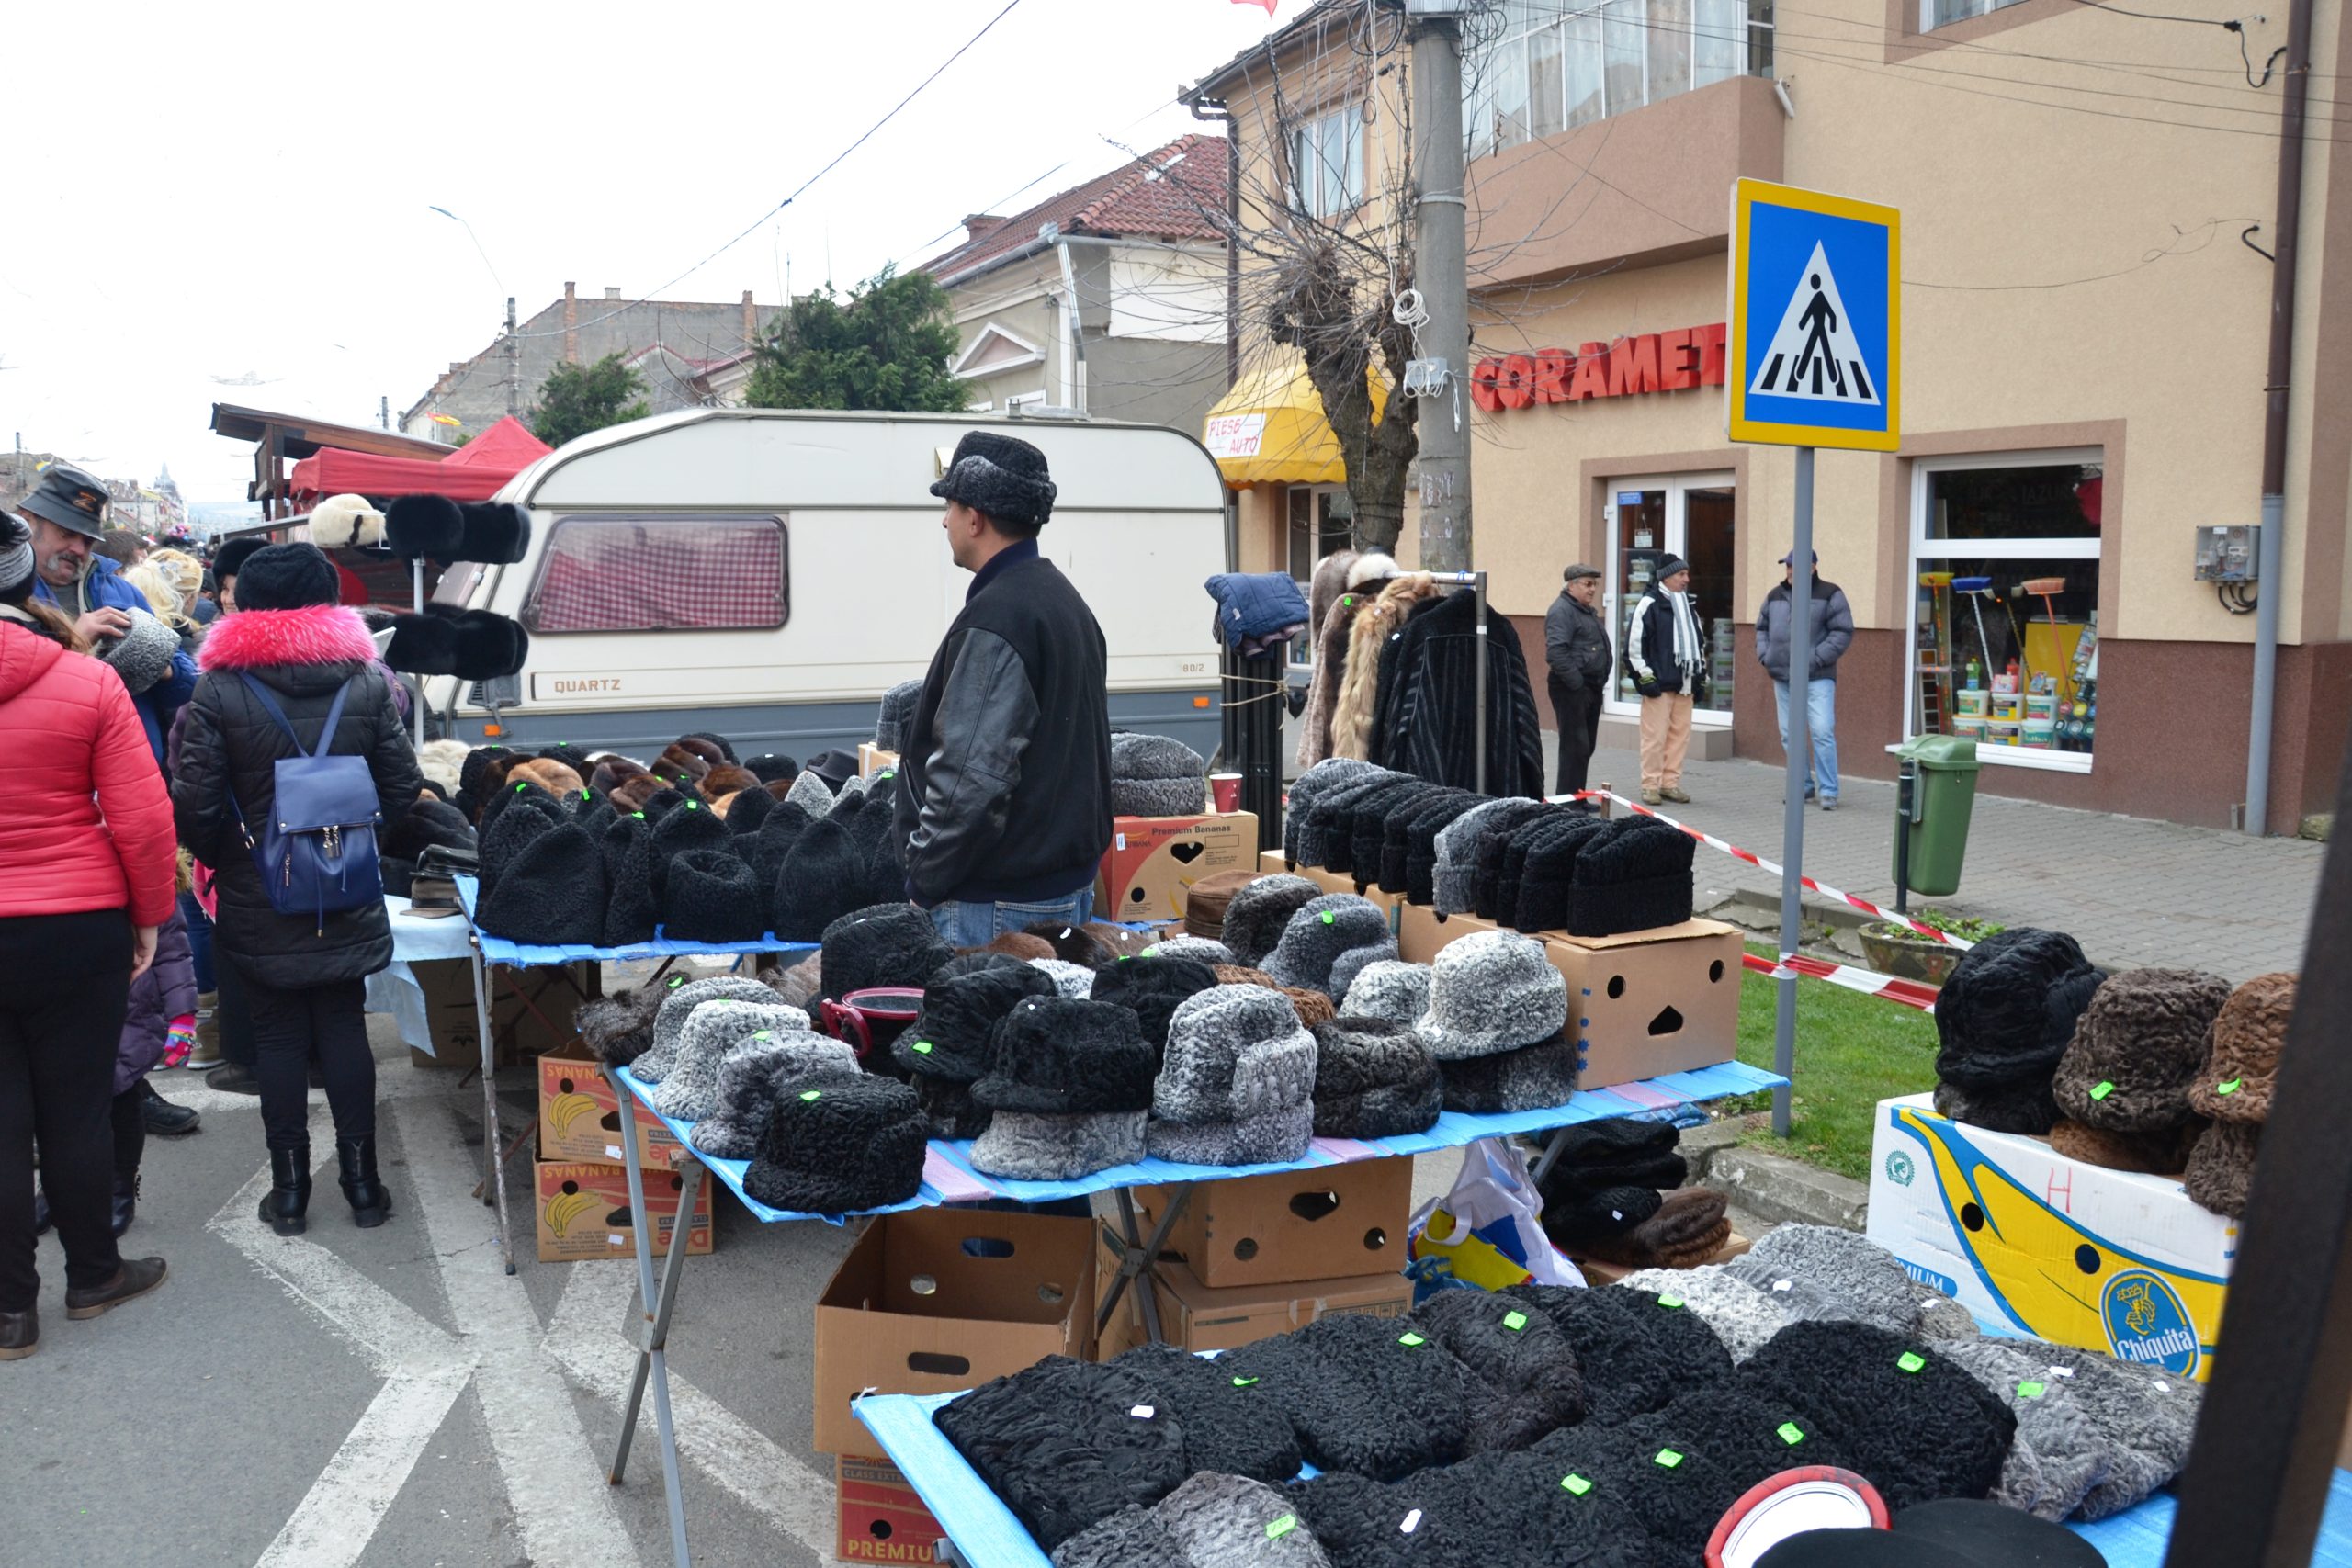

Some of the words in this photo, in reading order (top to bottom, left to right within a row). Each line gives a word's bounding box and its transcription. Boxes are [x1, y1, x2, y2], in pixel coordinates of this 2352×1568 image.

[1471, 322, 1726, 413] CORAMET
[1209, 418, 1241, 436] PIESE
[1229, 435, 1259, 454] AUTO
[554, 679, 621, 694] QUARTZ
[1152, 827, 1192, 836] Premium
[1194, 825, 1231, 834] Bananas
[546, 1065, 603, 1080] NANAS
[544, 1164, 621, 1179] BANANAS
[2116, 1328, 2195, 1365] Chiquita
[844, 1469, 875, 1480] CLASS
[876, 1472, 904, 1483] EXTR
[847, 1539, 933, 1562] PREMIU
